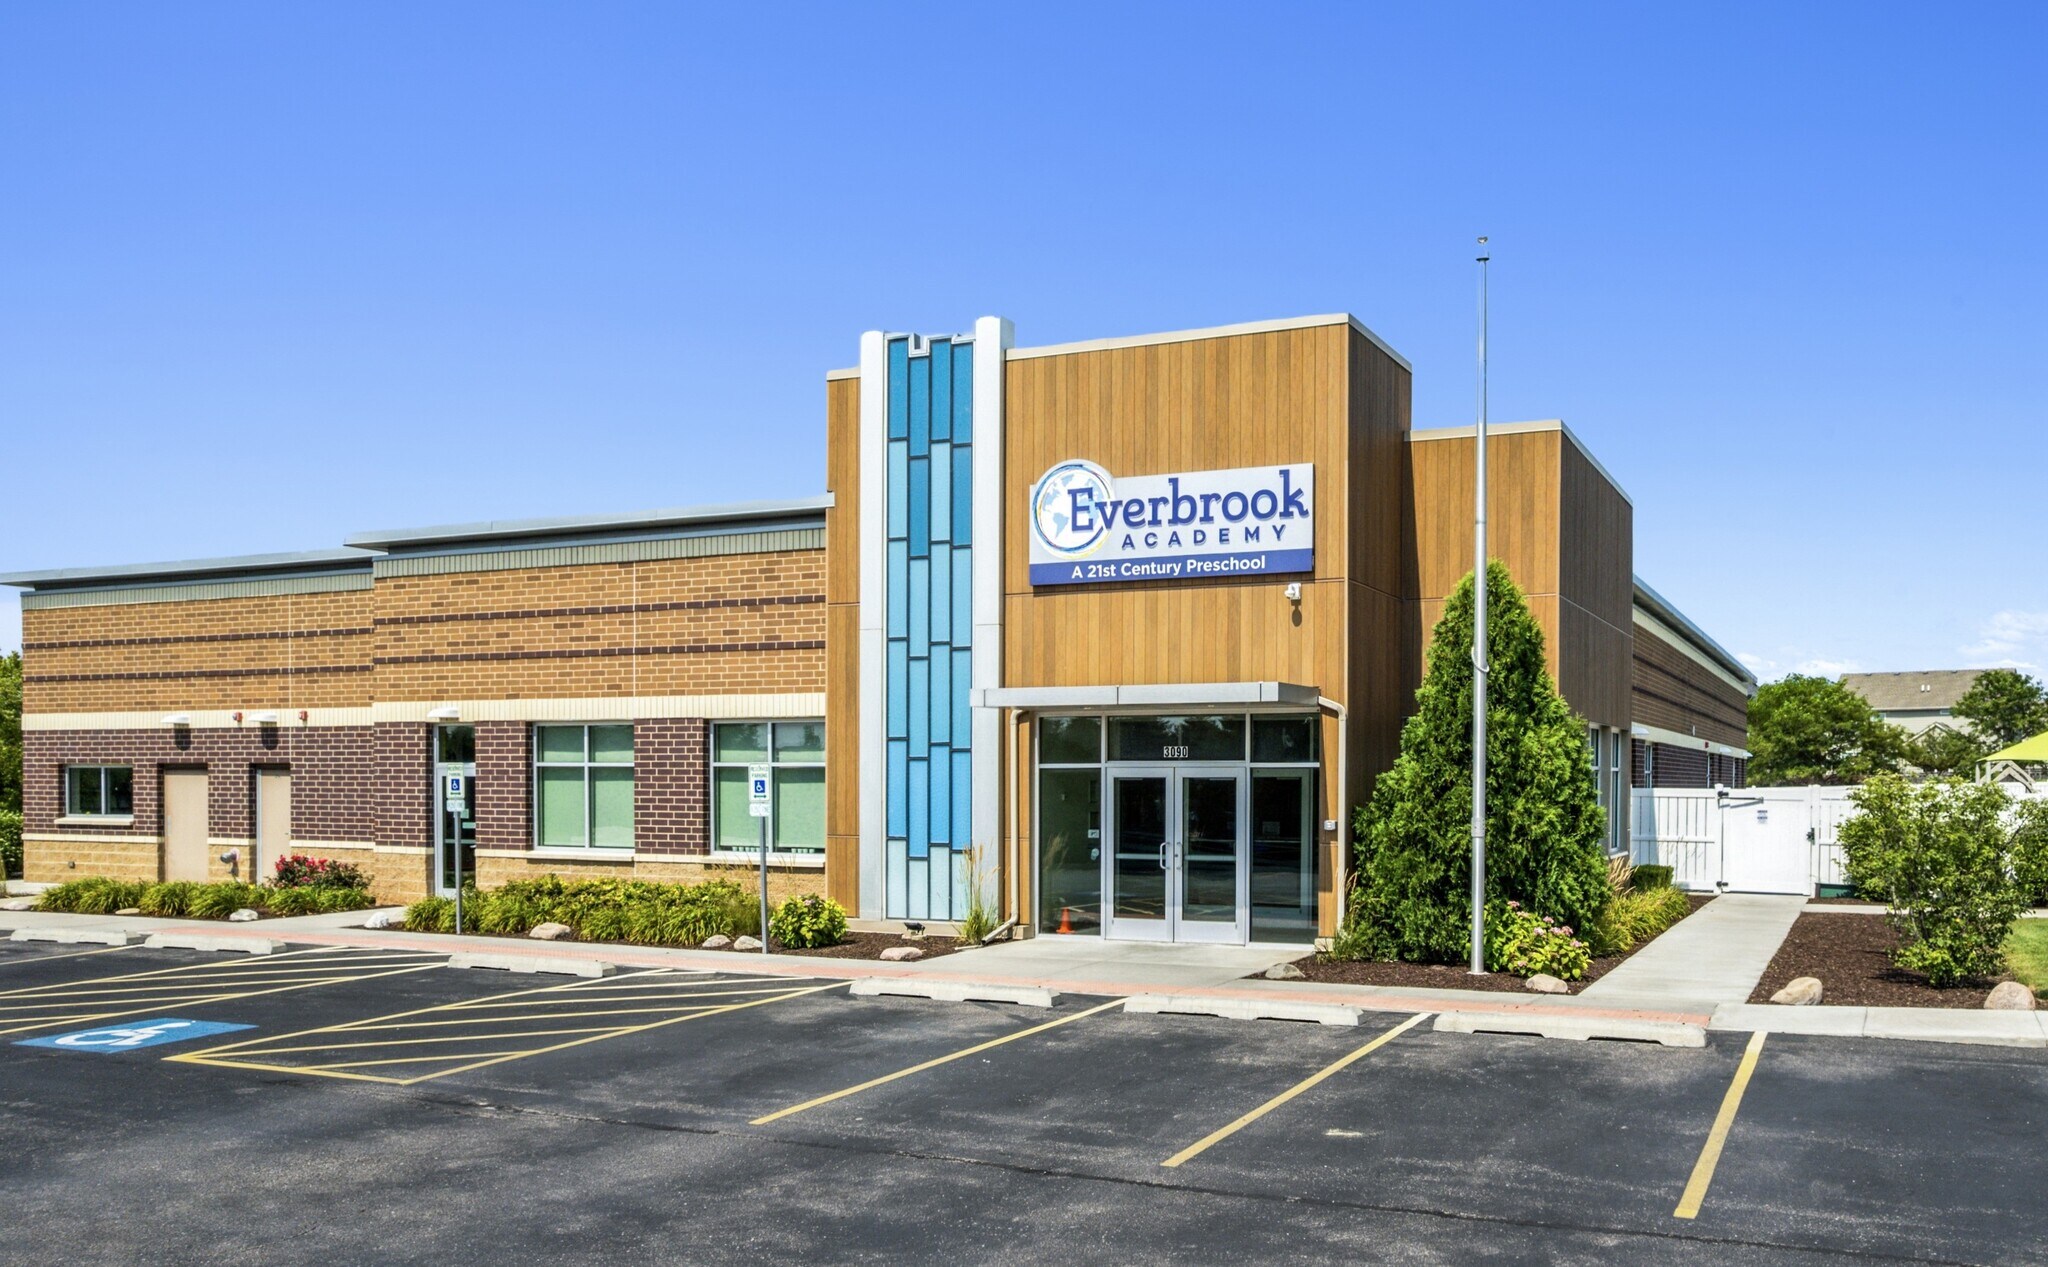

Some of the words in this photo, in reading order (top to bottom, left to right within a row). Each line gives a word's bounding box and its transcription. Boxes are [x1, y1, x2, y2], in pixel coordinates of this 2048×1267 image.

[1067, 469, 1310, 532] Everbrook
[1121, 524, 1287, 550] ACADEMY
[1071, 562, 1083, 579] A
[1087, 560, 1117, 578] 21st
[1121, 560, 1182, 577] Century
[1186, 555, 1266, 573] Preschool
[1164, 746, 1188, 757] 3090
